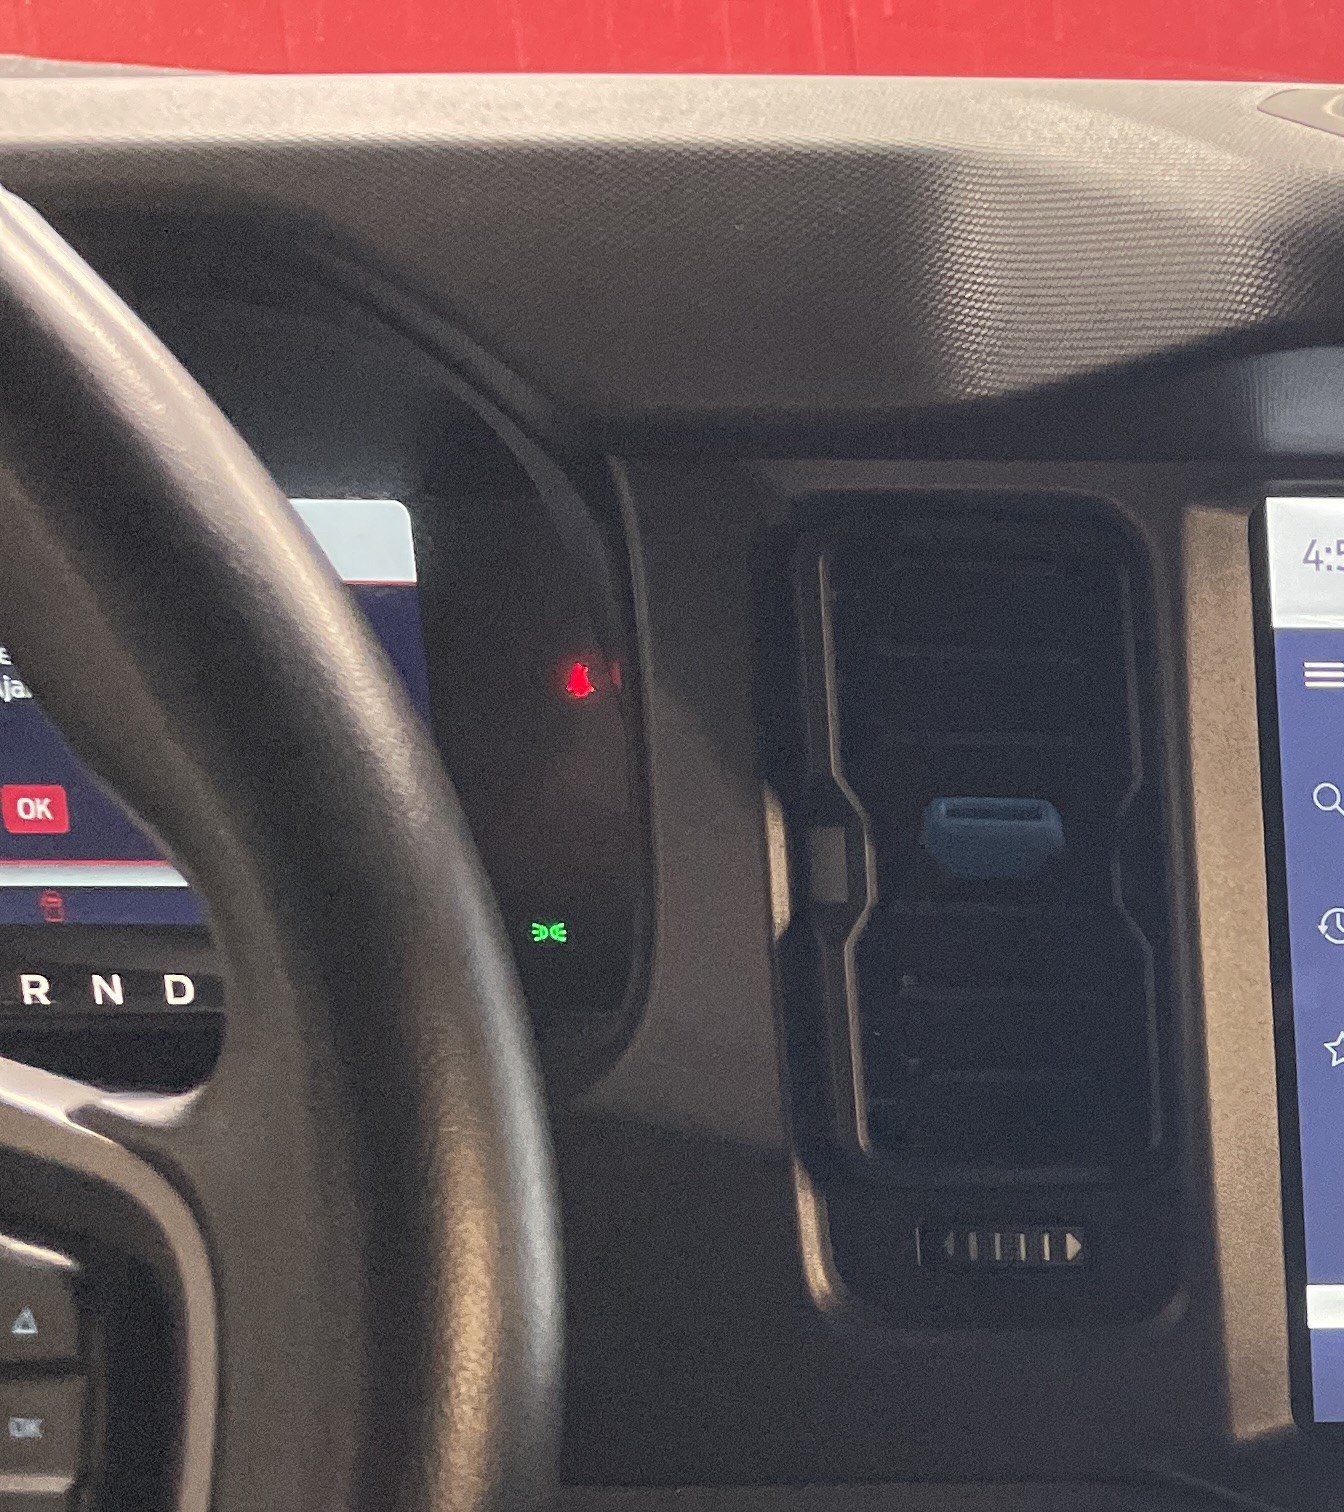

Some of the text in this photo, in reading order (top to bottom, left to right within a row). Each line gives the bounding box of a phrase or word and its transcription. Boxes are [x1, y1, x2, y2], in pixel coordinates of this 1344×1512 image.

[16, 797, 53, 820] OK
[20, 974, 195, 1005] R N D
